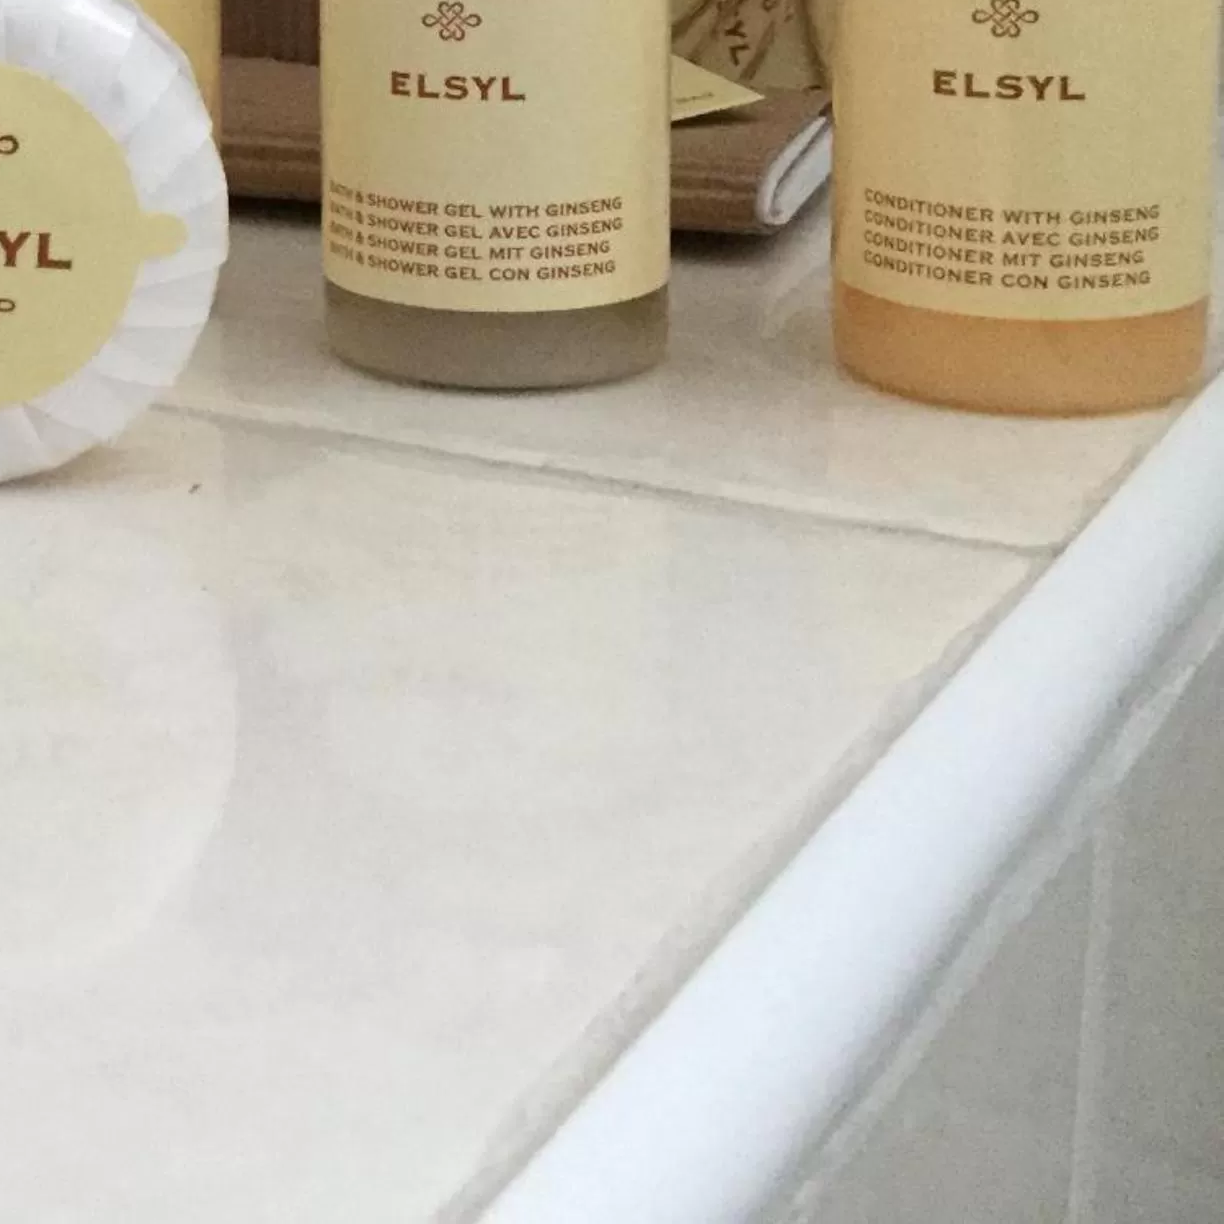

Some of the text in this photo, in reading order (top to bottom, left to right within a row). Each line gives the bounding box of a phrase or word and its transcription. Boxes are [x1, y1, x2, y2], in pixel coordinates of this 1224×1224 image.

[390, 71, 526, 101] ELSYL
[933, 68, 1086, 101] ELSYL
[368, 194, 439, 216] SHOWER
[444, 204, 482, 218] GEL
[488, 205, 539, 219] WITH
[545, 196, 623, 217] GINSENG
[864, 188, 1160, 226] CONDITIONER WITH GINSENG
[368, 216, 439, 237] SHOWER
[444, 224, 482, 239] GEL
[489, 225, 540, 239] AVEC
[546, 217, 623, 238] GINSENG
[864, 209, 1159, 247] CONDITIONER AVEC GINSENG
[368, 236, 439, 257] SHOWER
[444, 245, 482, 260] GEL
[489, 247, 525, 260] MIT
[530, 240, 610, 259] GINSENG
[864, 230, 1144, 268] CONDITIONER MIT GINSENG
[368, 256, 439, 278] SHOWER
[444, 266, 482, 281] GEL
[489, 268, 529, 281] CON
[536, 260, 615, 280] GINSENG
[864, 250, 1150, 290] CONDITIONER CON GINSENG
